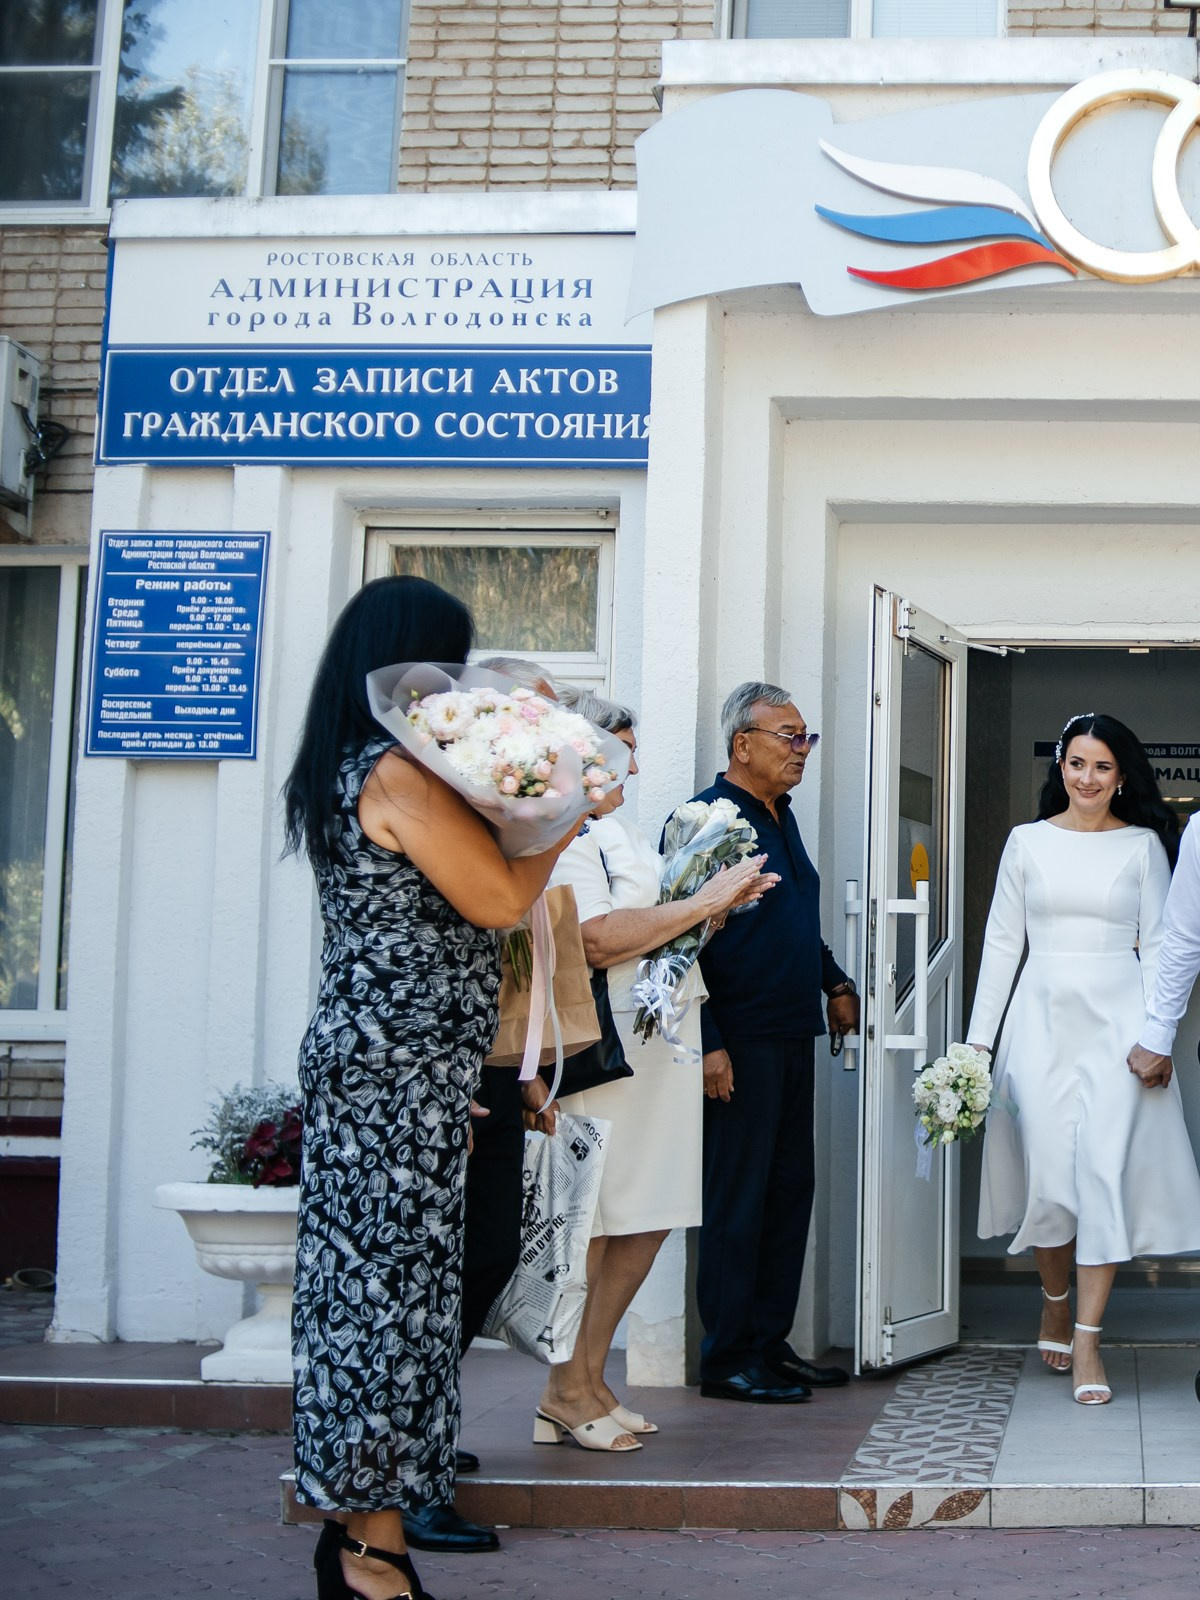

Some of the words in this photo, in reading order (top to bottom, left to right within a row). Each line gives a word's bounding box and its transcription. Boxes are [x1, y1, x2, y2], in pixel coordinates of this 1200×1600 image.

[267, 252, 415, 266] РОСТОВСКАЯ
[431, 252, 533, 266] ОБЛАСТЬ
[210, 277, 594, 303] АДМИНИСТРАЦИЯ
[208, 309, 332, 332] города
[352, 302, 593, 328] Волгодонска
[169, 367, 295, 399] ОТДЕЛ
[313, 368, 473, 393] ЗАПИСИ
[490, 368, 618, 394] АКТОВ
[122, 411, 419, 443] ГРАЖДАНСКОГО
[108, 539, 128, 548] Отдел
[130, 540, 153, 548] записи
[121, 550, 173, 559] Администрации
[175, 552, 198, 560] города
[148, 561, 185, 569] Ростовской
[188, 561, 215, 570] области
[136, 579, 179, 589] Режим
[184, 580, 231, 591] работы
[108, 598, 144, 607] Вторник
[112, 608, 138, 618] Среда
[177, 605, 199, 613] Приём
[106, 619, 143, 628] Пятница
[105, 639, 140, 649] Четверг
[176, 641, 221, 649] неприёмный
[223, 642, 241, 650] день
[104, 668, 139, 678] Суббота
[172, 666, 195, 674] Приём
[102, 699, 151, 709] Воскресенье
[101, 710, 151, 720] Понедельник
[175, 706, 217, 715] Выходные
[220, 707, 236, 715] дни
[98, 730, 140, 739] Последний
[142, 731, 162, 739] день
[164, 732, 192, 740] месяца
[122, 740, 146, 748] приём
